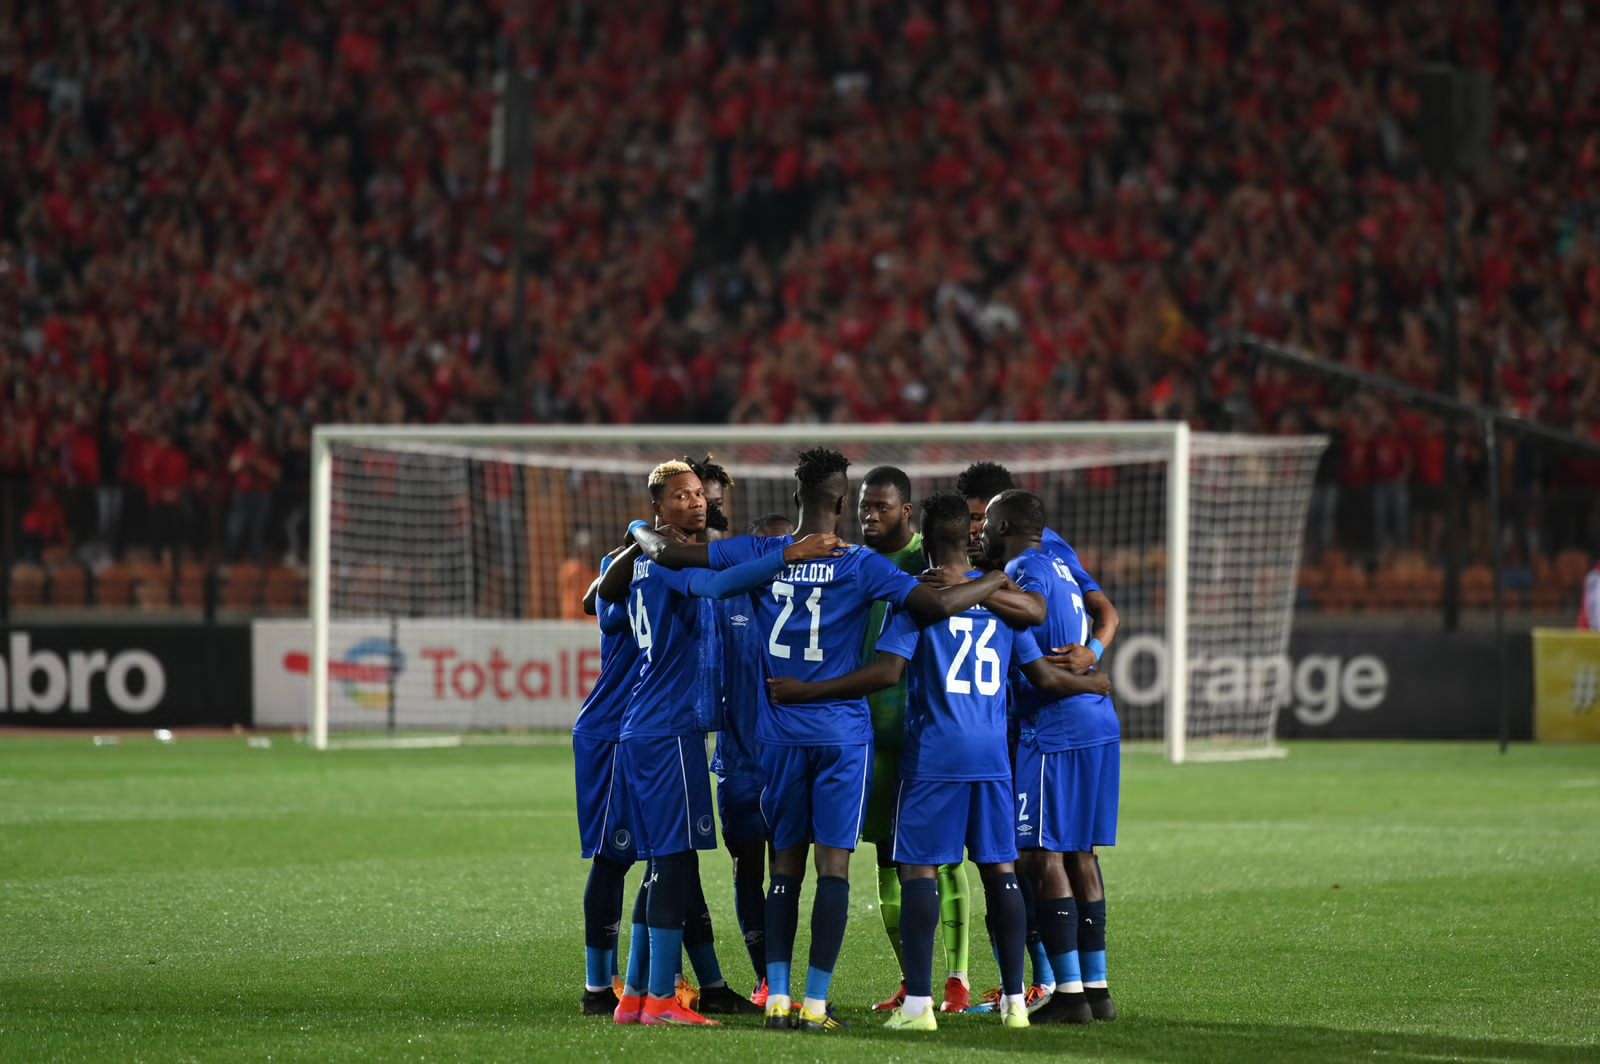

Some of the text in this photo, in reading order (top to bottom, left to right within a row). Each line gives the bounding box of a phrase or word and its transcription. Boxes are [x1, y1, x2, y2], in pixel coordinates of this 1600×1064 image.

[768, 581, 824, 662] 21
[946, 616, 1001, 696] 26
[0, 631, 166, 713] bro
[421, 647, 601, 700] TotalE
[1018, 792, 1029, 821] 2
